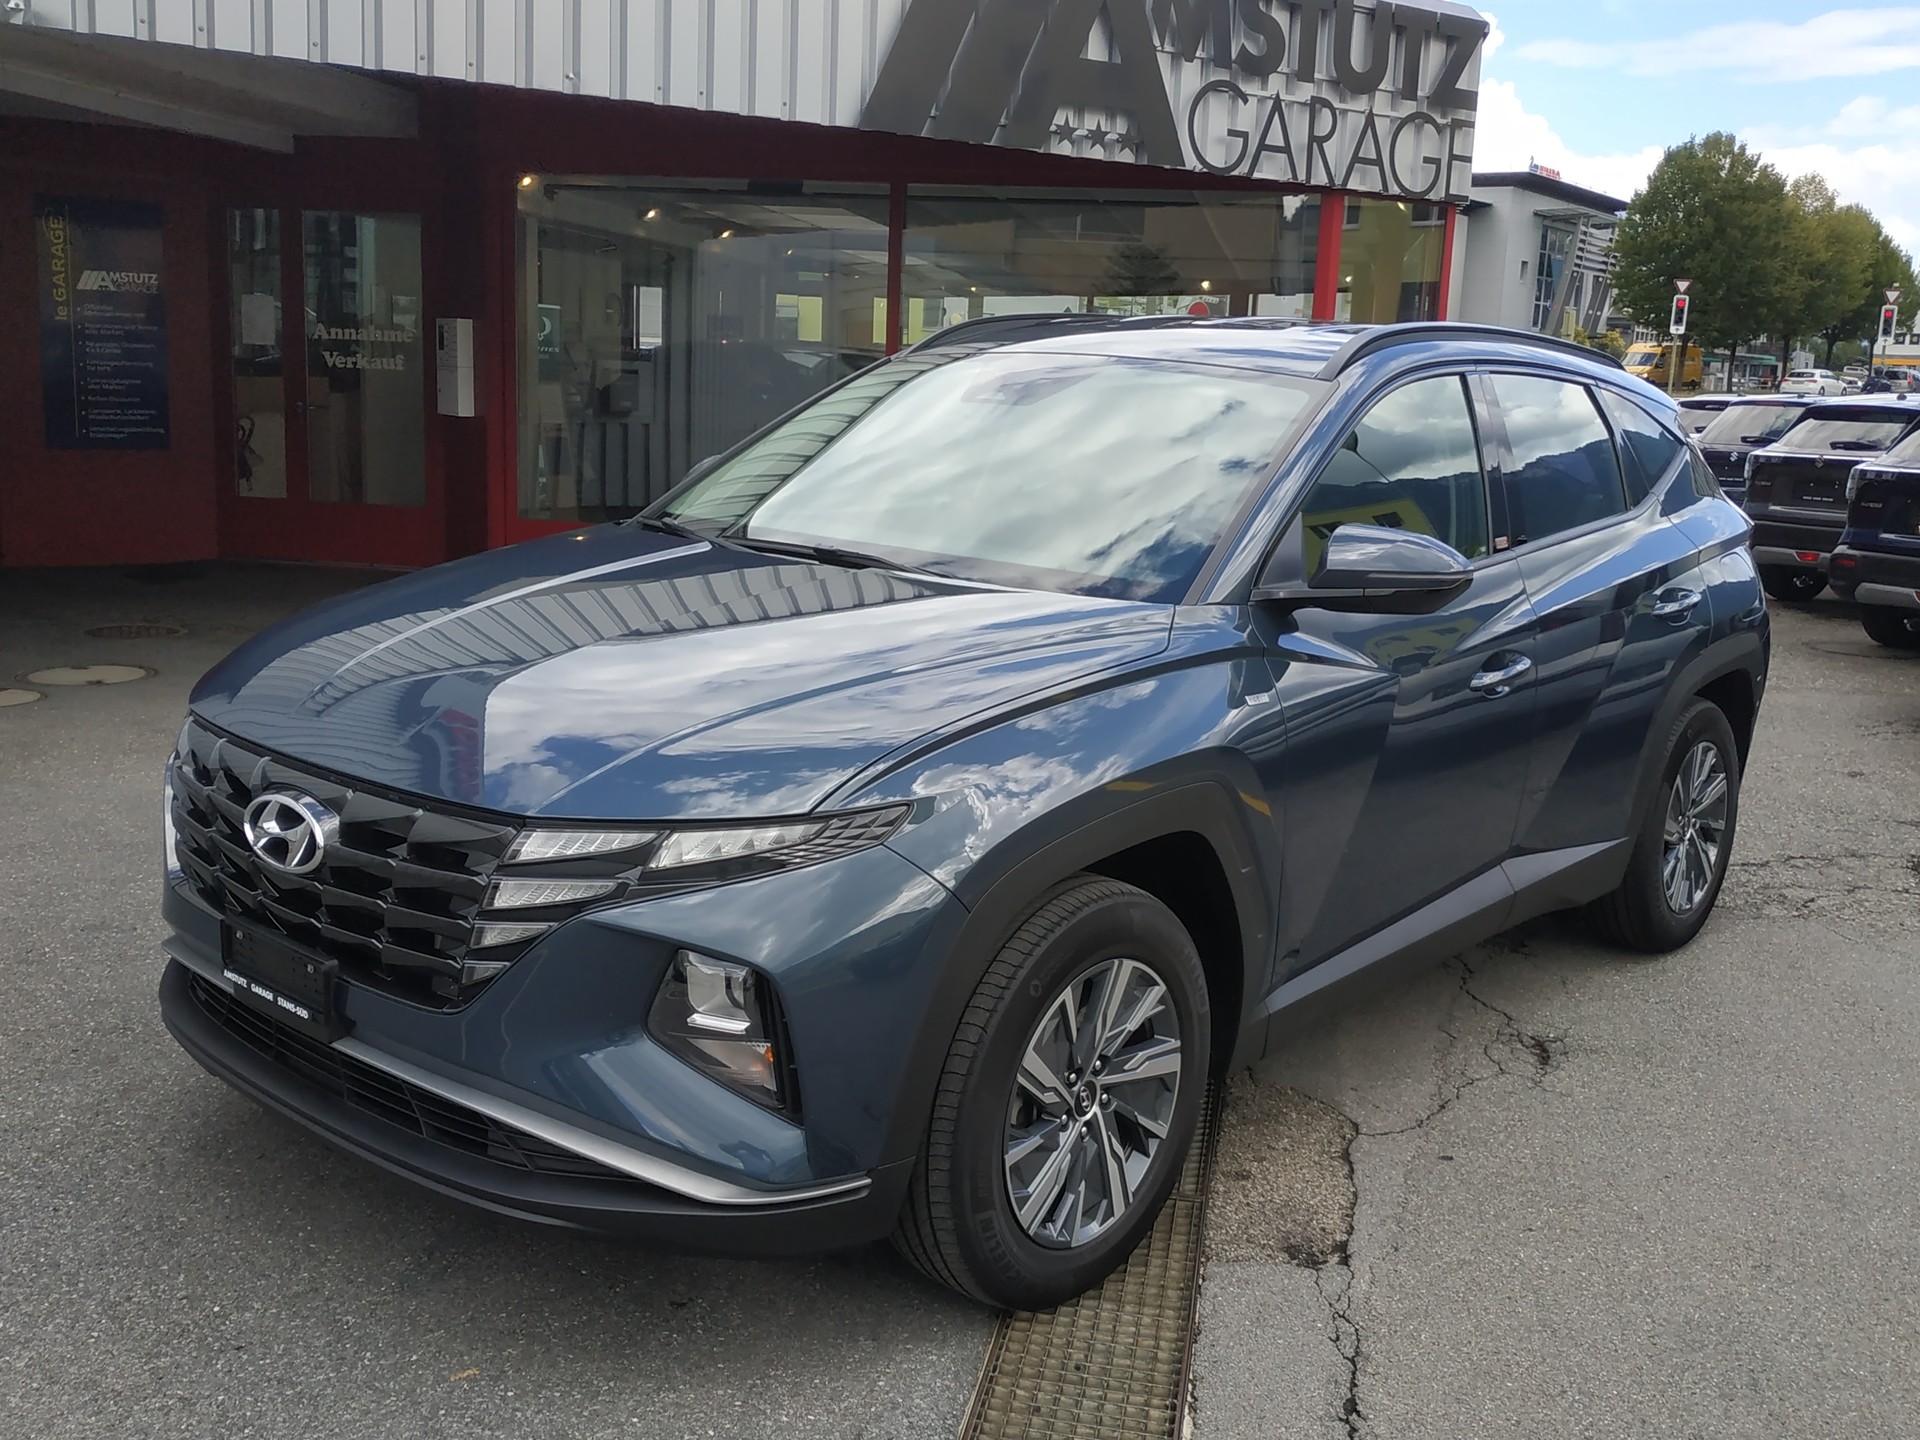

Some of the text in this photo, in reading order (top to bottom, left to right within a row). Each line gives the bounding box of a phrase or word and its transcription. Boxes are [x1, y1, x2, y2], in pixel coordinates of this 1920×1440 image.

[1187, 79, 1476, 201] GARAGE
[50, 215, 67, 302] GARAGE
[93, 270, 158, 291] AMSTUTZ
[312, 322, 414, 342] Annahme
[322, 351, 405, 371] Verkauf
[223, 969, 248, 988] AMSTUTZ
[250, 983, 274, 1001] GARAGE
